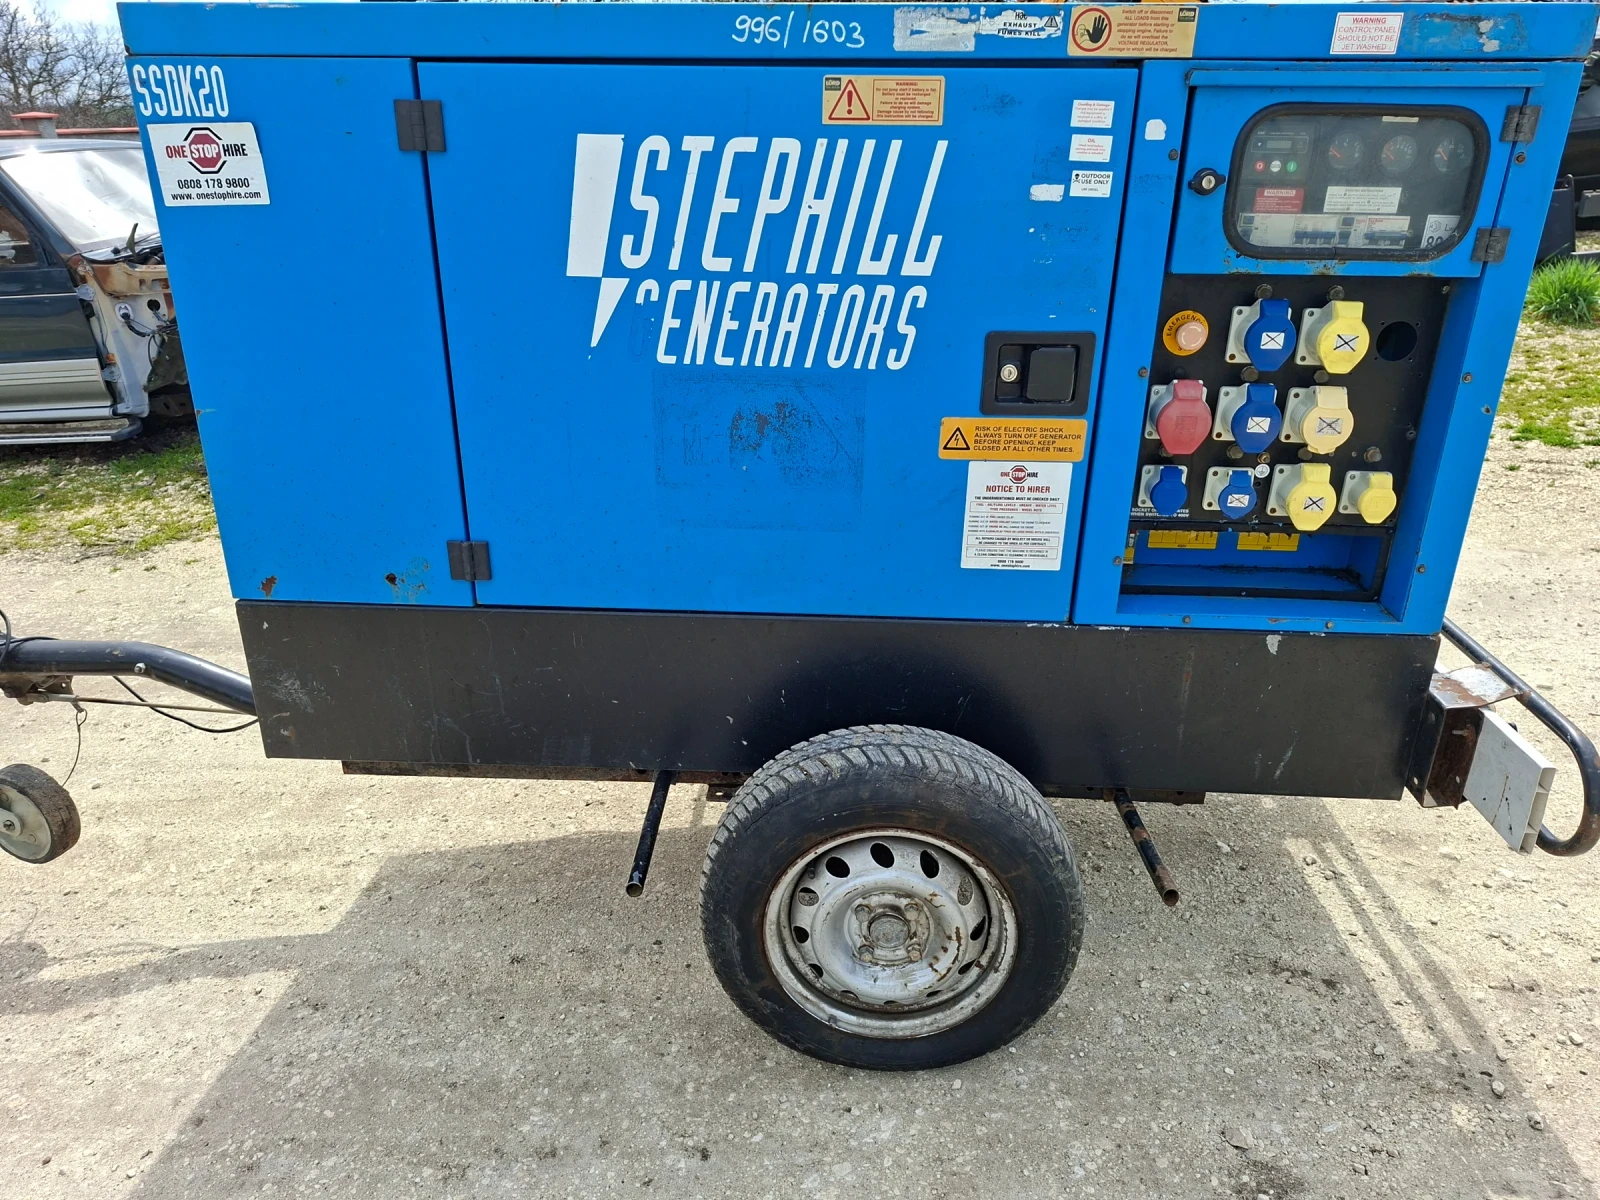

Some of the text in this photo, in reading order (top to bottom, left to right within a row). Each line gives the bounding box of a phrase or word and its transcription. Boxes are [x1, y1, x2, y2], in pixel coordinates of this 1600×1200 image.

[133, 64, 229, 117] SSDK20
[166, 143, 248, 159] ONE STOP HIRE
[177, 178, 250, 189] 0808 178 9800
[171, 191, 261, 201] www. onestophire.com
[620, 134, 948, 276] STEPHILL
[1028, 485, 1050, 493] HIRER
